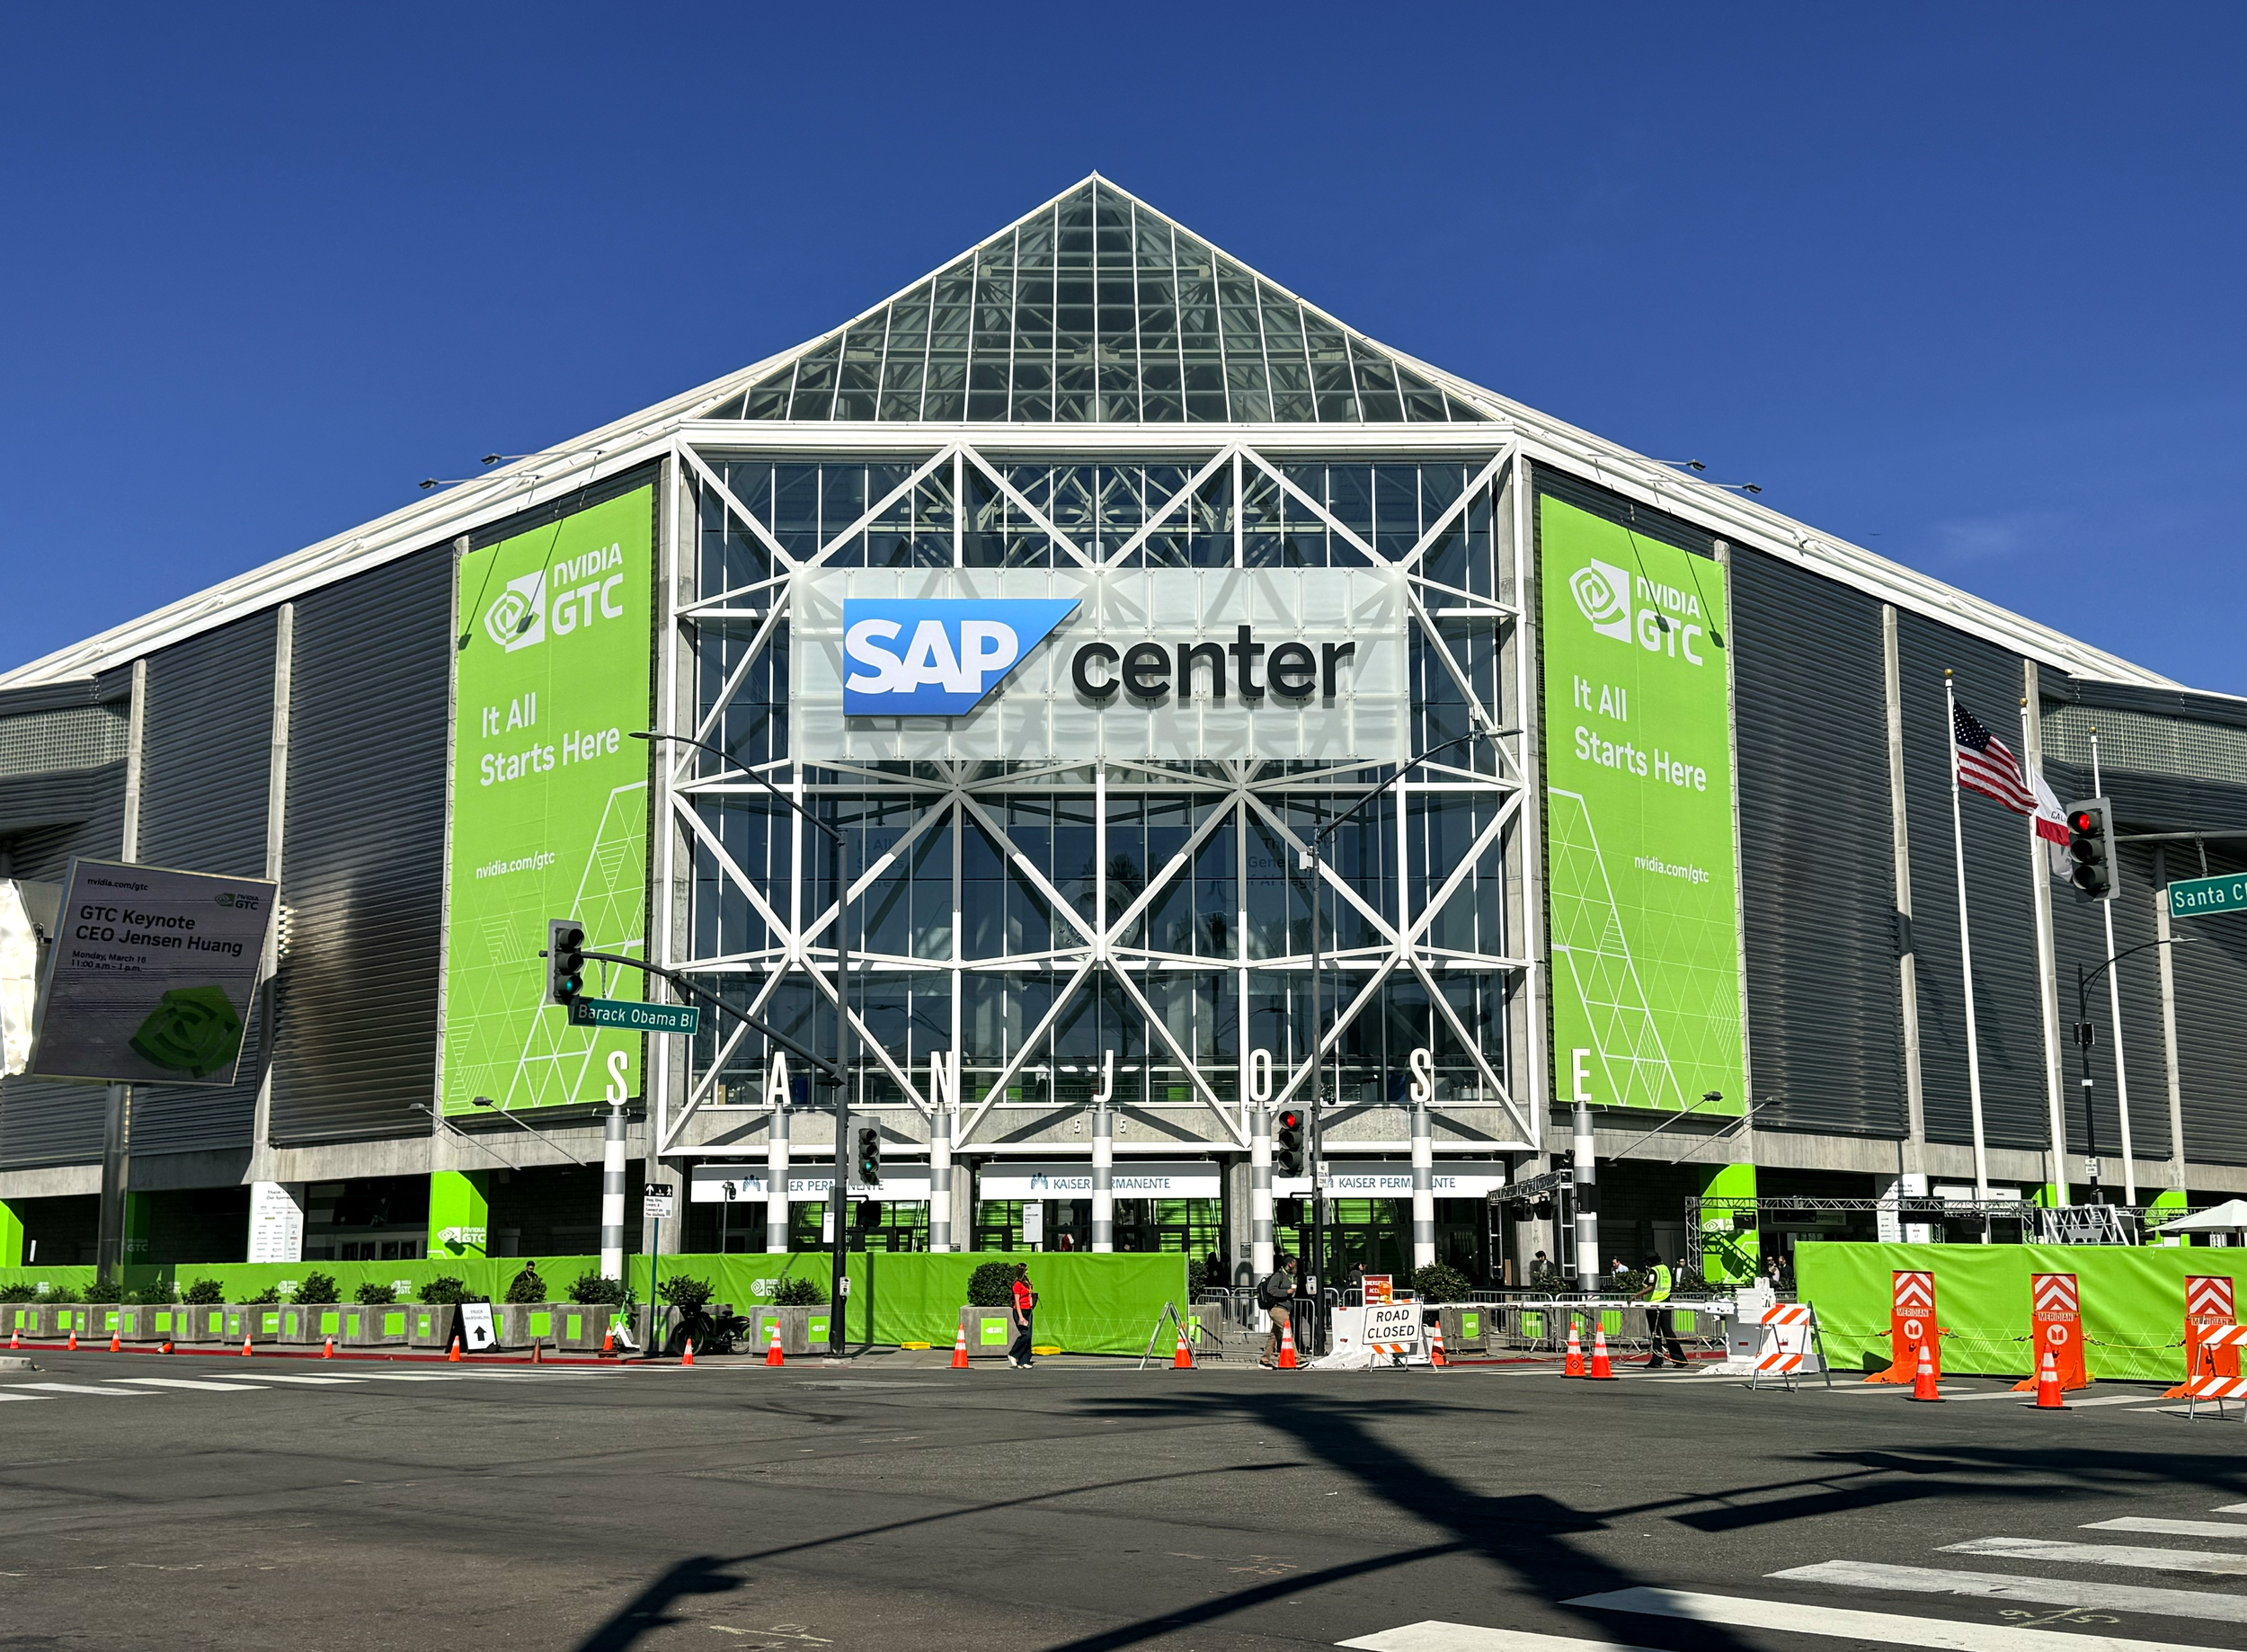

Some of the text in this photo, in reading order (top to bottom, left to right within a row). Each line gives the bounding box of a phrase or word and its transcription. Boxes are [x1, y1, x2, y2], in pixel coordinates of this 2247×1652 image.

[554, 542, 623, 587] NVIDIA
[552, 573, 623, 635] GTC
[1637, 575, 1701, 619] NVIDIA
[1638, 608, 1702, 667] GTC
[845, 618, 1355, 699] SAP center
[1574, 675, 1627, 722] It All
[483, 692, 536, 738] It All
[480, 727, 620, 786] Starts Here
[1576, 726, 1707, 792] Starts Here
[476, 850, 555, 879] nvidia.com/gtc
[1634, 856, 1710, 884] nvidia.com/gtc
[87, 878, 148, 892] nvidia.com/gtc
[235, 900, 259, 910] GTC
[2175, 887, 2225, 908] Santa
[80, 905, 196, 930] GTC Keynote
[75, 925, 243, 957] CEO Jensen Huang
[72, 950, 147, 964] Monday, March 16
[72, 959, 93, 968] 11:00
[579, 1005, 626, 1022] Barack
[631, 1009, 676, 1026] Obama
[1053, 1178, 1090, 1189] KAISER
[1339, 1177, 1376, 1188] KAISER
[128, 1244, 148, 1252] GTC
[463, 1233, 486, 1243] GTC
[1376, 1310, 1409, 1322] ROAD
[2038, 1312, 2074, 1321] MERIDIAN
[1367, 1325, 1415, 1339] CLOSED
